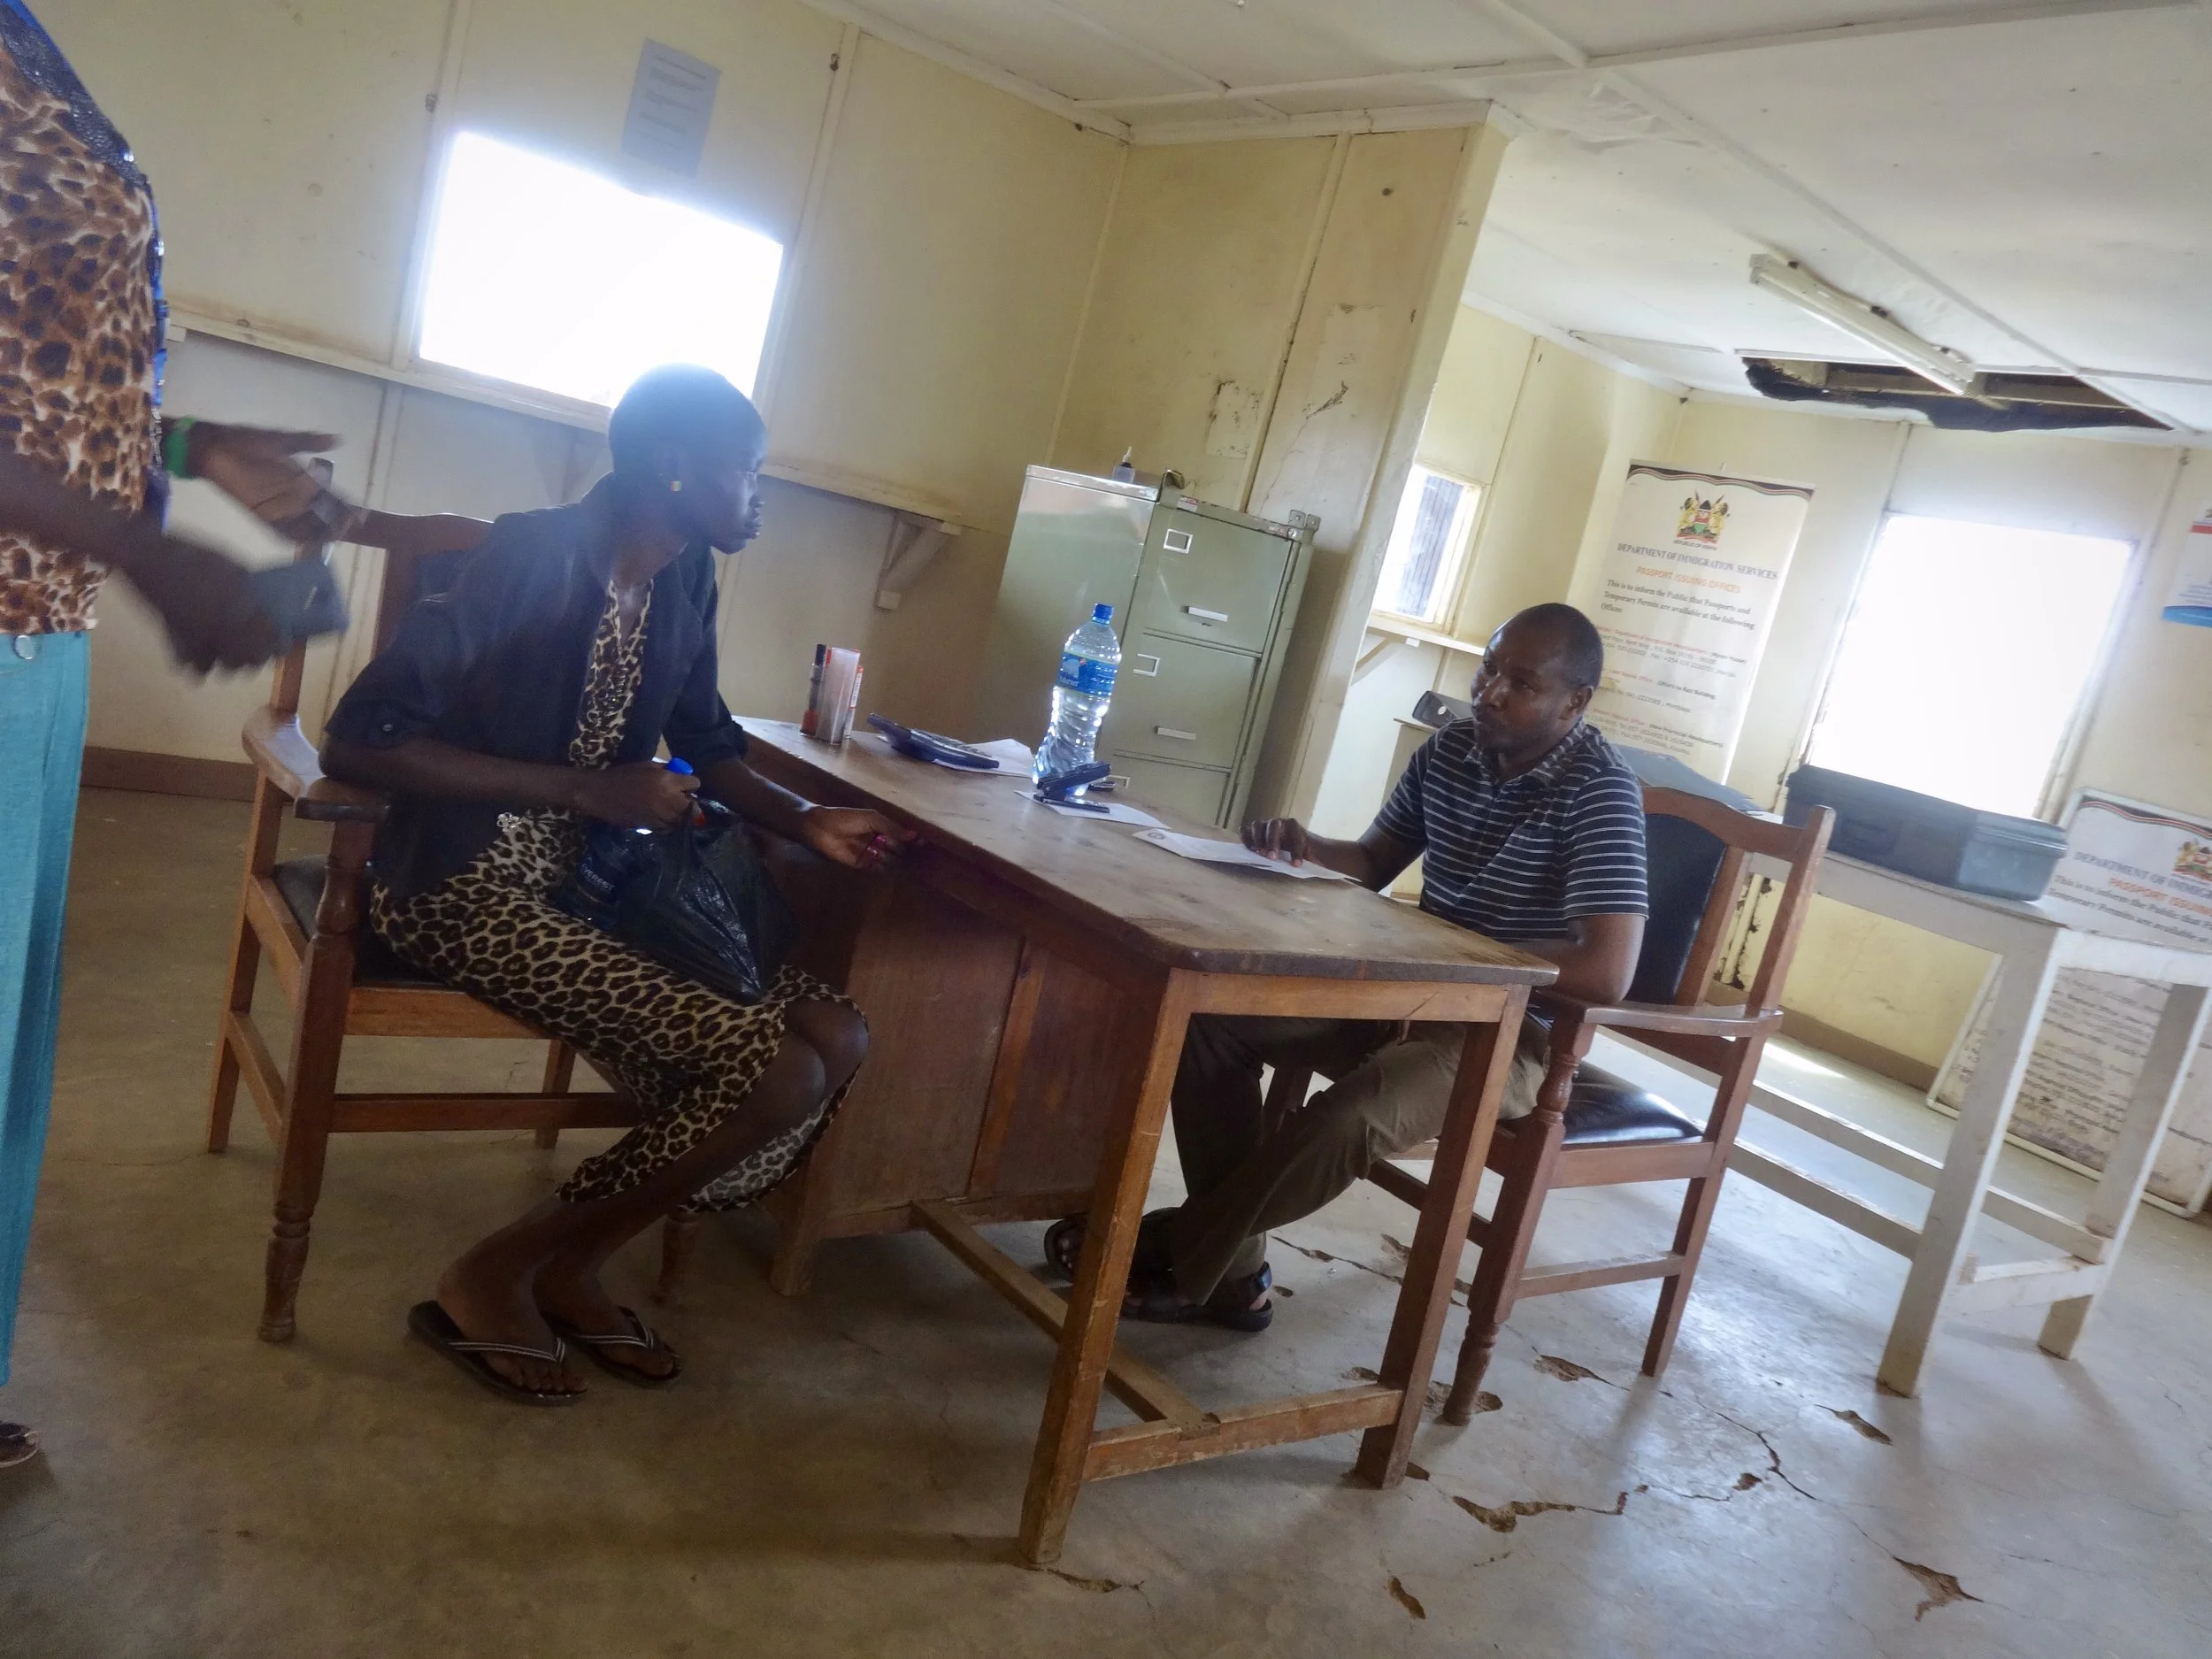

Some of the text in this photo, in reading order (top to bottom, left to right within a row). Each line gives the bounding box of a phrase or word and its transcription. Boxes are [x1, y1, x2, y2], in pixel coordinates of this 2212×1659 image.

[1617, 543, 1667, 559] DEPARTMENT
[1678, 554, 1734, 571] IMMIGRATION
[1736, 565, 1778, 580] SERVICES
[1634, 585, 1655, 595] inform
[1667, 591, 1688, 602] Public
[1637, 566, 1673, 580] PASSPORT
[1709, 580, 1740, 594] OFFICES
[1709, 613, 1721, 622] the
[1722, 616, 1755, 630] following
[2074, 851, 2149, 879] DEPARTMENT
[2150, 873, 2168, 885] OF
